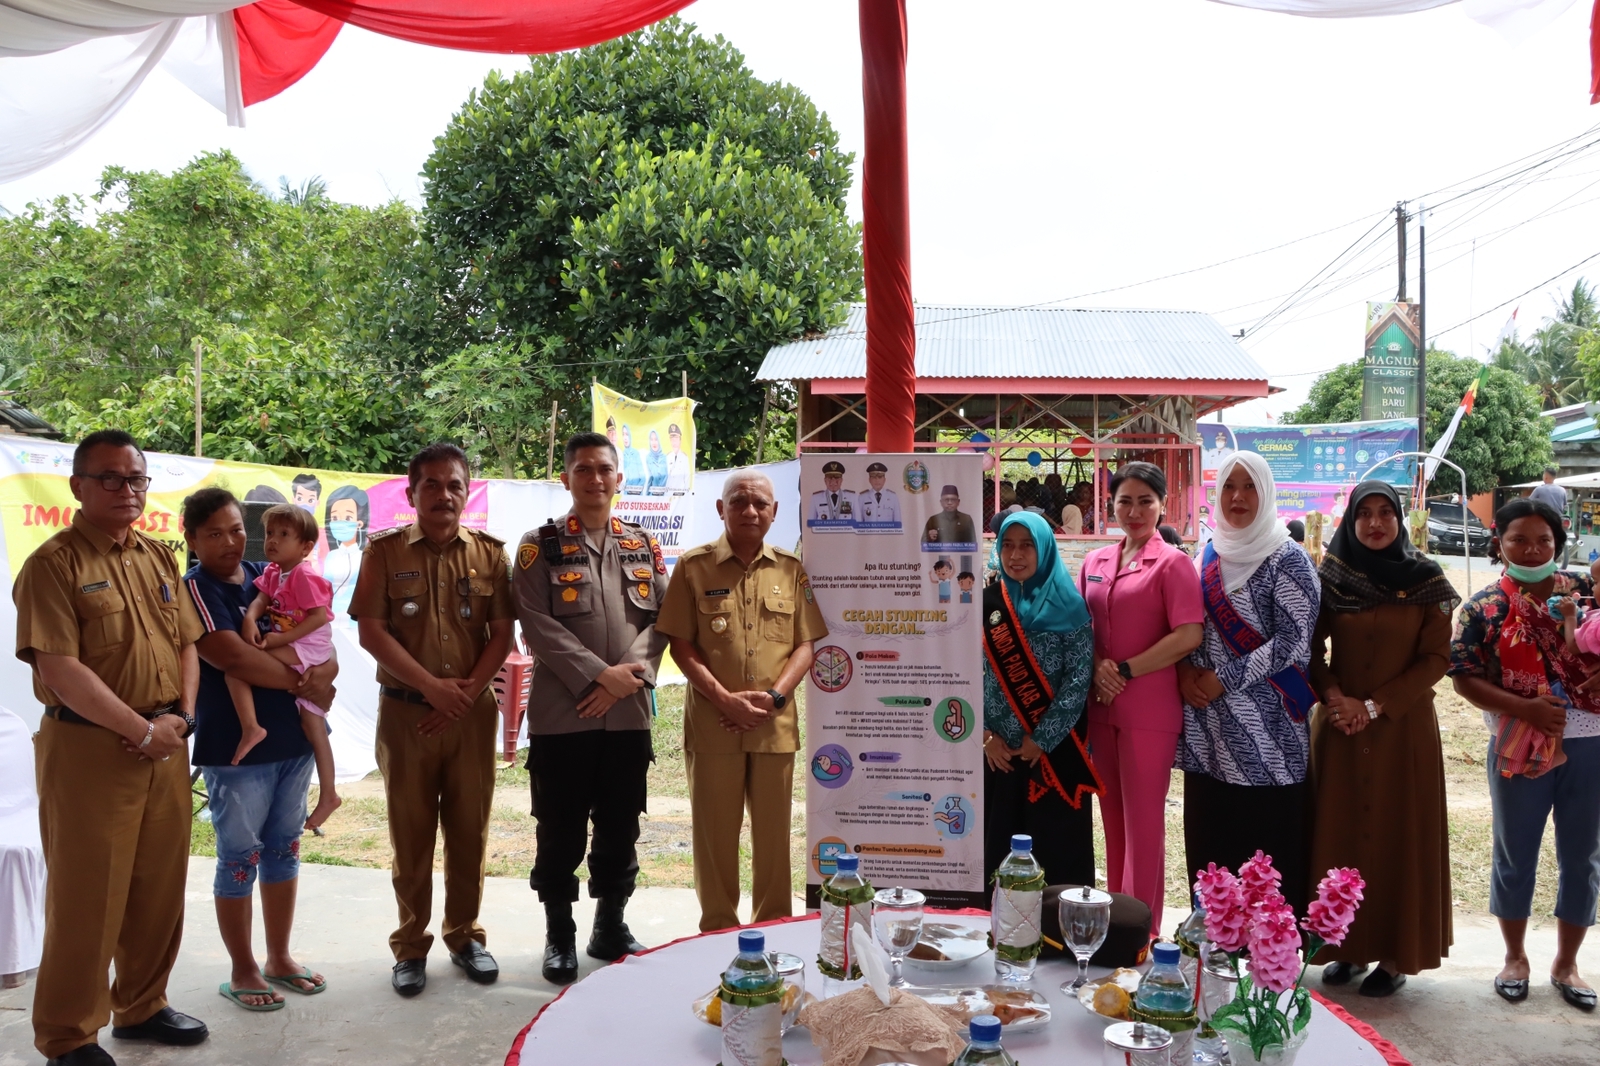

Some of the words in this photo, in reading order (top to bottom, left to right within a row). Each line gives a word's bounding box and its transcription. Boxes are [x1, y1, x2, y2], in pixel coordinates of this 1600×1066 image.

[1372, 368, 1415, 377] CLASSIC
[1382, 386, 1405, 395] YANG
[1382, 398, 1405, 407] BARU
[1382, 411, 1405, 419] YANG
[1257, 444, 1294, 452] GERMAS
[615, 501, 629, 511] AYO
[620, 552, 651, 564] POLRI
[864, 563, 877, 571] Apa
[890, 563, 921, 571] stunting?
[842, 609, 883, 622] CEGAH
[885, 609, 948, 622] STUNTING
[1214, 602, 1237, 634] KEC.
[864, 622, 926, 635] DENGAN...
[990, 622, 1015, 657] BUNDA
[1003, 653, 1029, 683] PAUD
[1015, 680, 1040, 709] KAB.
[904, 847, 927, 855] Kembang
